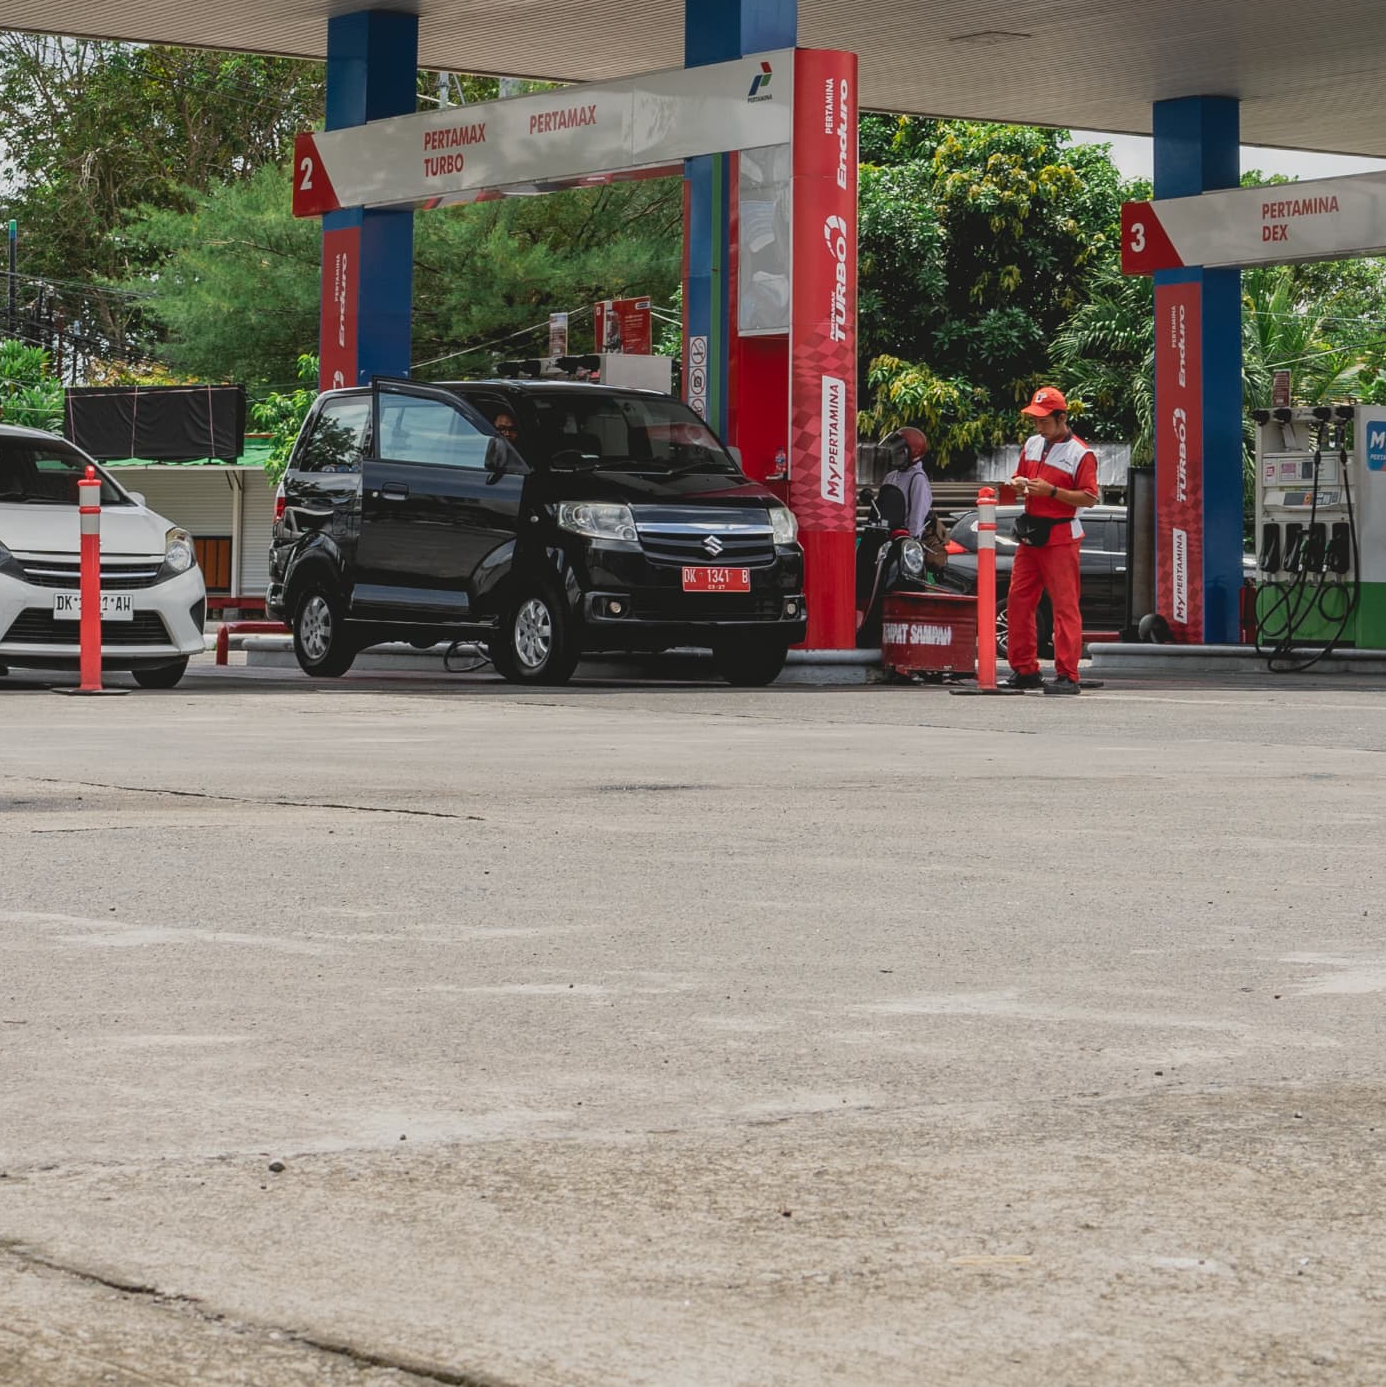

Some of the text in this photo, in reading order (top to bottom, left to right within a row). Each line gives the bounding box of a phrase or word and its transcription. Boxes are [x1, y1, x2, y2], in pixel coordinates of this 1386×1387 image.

[529, 105, 597, 134] PERTAMAX
[825, 77, 834, 135] PERTAMINA
[424, 123, 487, 151] PERTAMAX
[836, 79, 848, 191] Enduro
[299, 157, 313, 191] 2
[424, 153, 464, 177] TURBO
[1262, 196, 1340, 219] PERTAMINA
[1130, 222, 1146, 253] 3
[1262, 224, 1289, 242] DEX
[835, 236, 847, 342] TURBO
[685, 568, 697, 583] DK
[707, 569, 729, 583] 1341
[56, 595, 73, 610] DK
